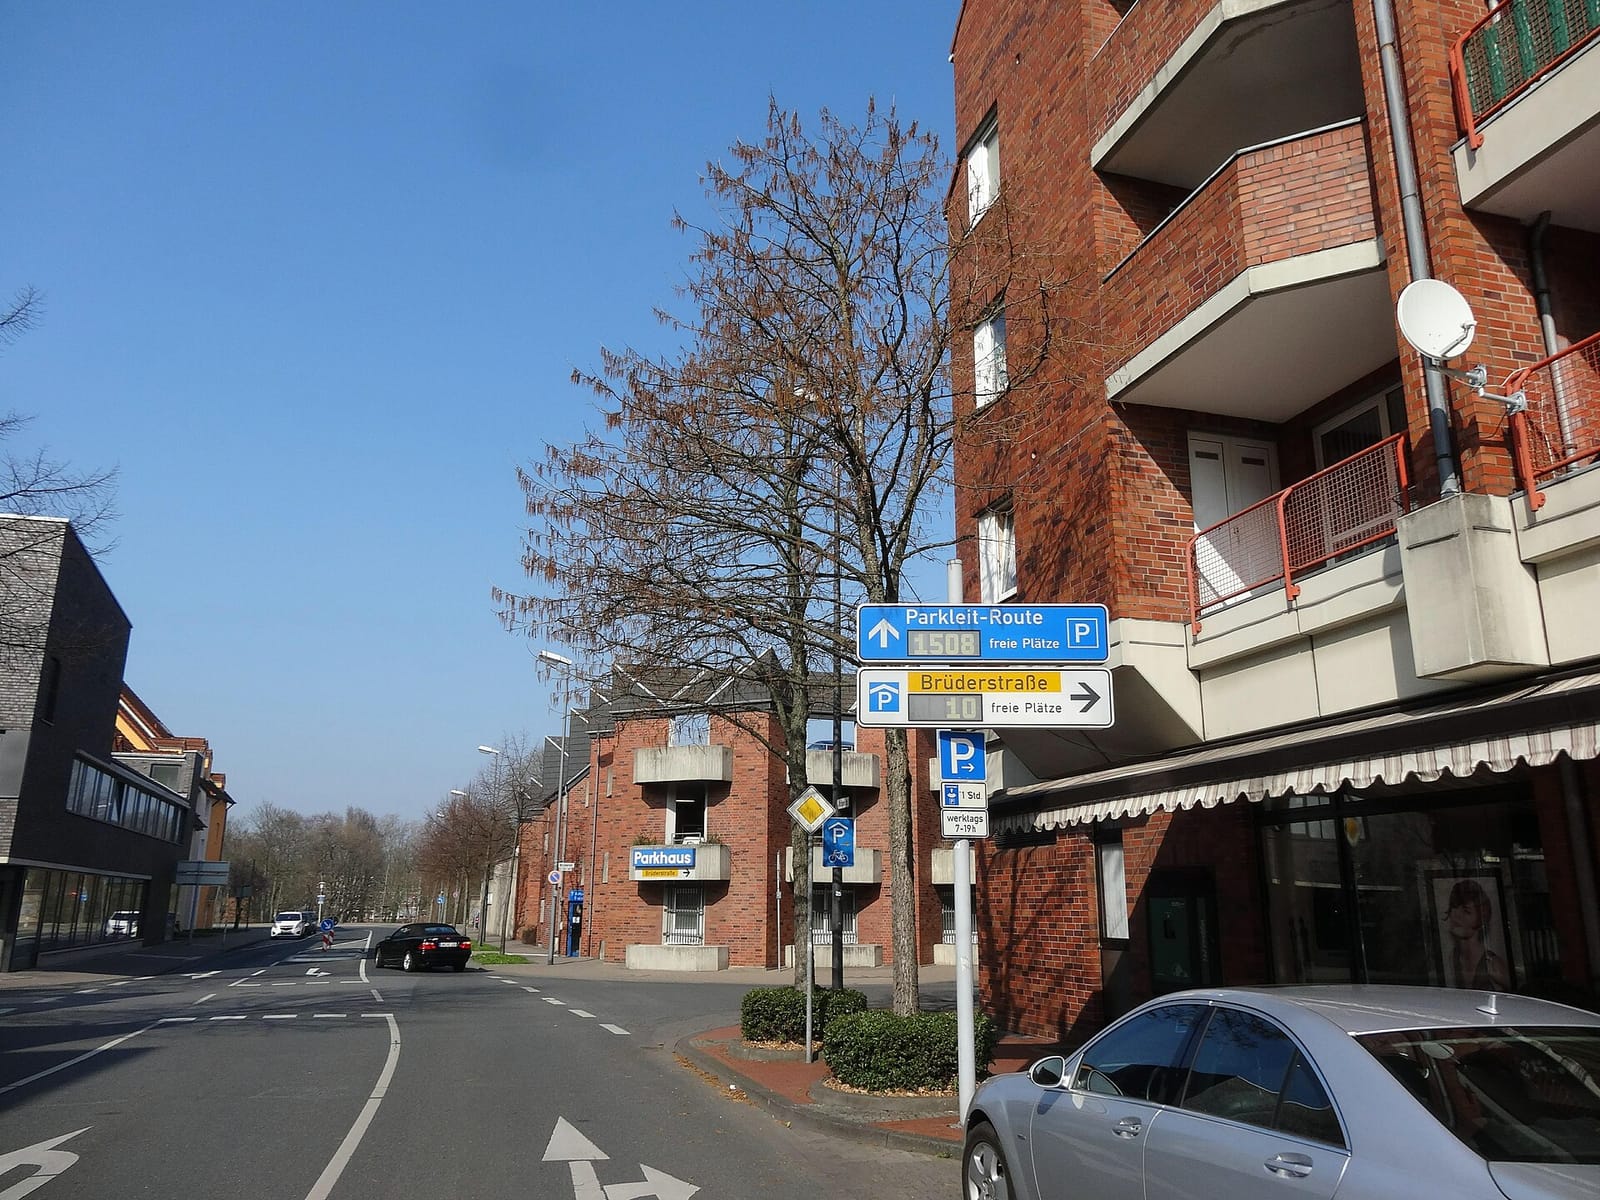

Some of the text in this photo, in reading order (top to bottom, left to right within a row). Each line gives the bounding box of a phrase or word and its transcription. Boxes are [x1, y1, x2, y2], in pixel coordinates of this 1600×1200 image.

[906, 609, 1043, 625] Parkleit-Route
[1074, 624, 1091, 643] P
[914, 633, 975, 655] 1508
[989, 638, 1060, 649] freie Plätze
[921, 674, 1048, 690] Brüderstraße
[878, 692, 892, 711] P
[946, 697, 977, 719] 10
[991, 702, 1062, 713] freie Plätze
[950, 738, 975, 774] P
[947, 814, 984, 825] werktags
[833, 828, 845, 844] P
[634, 851, 692, 864] Parkhaus
